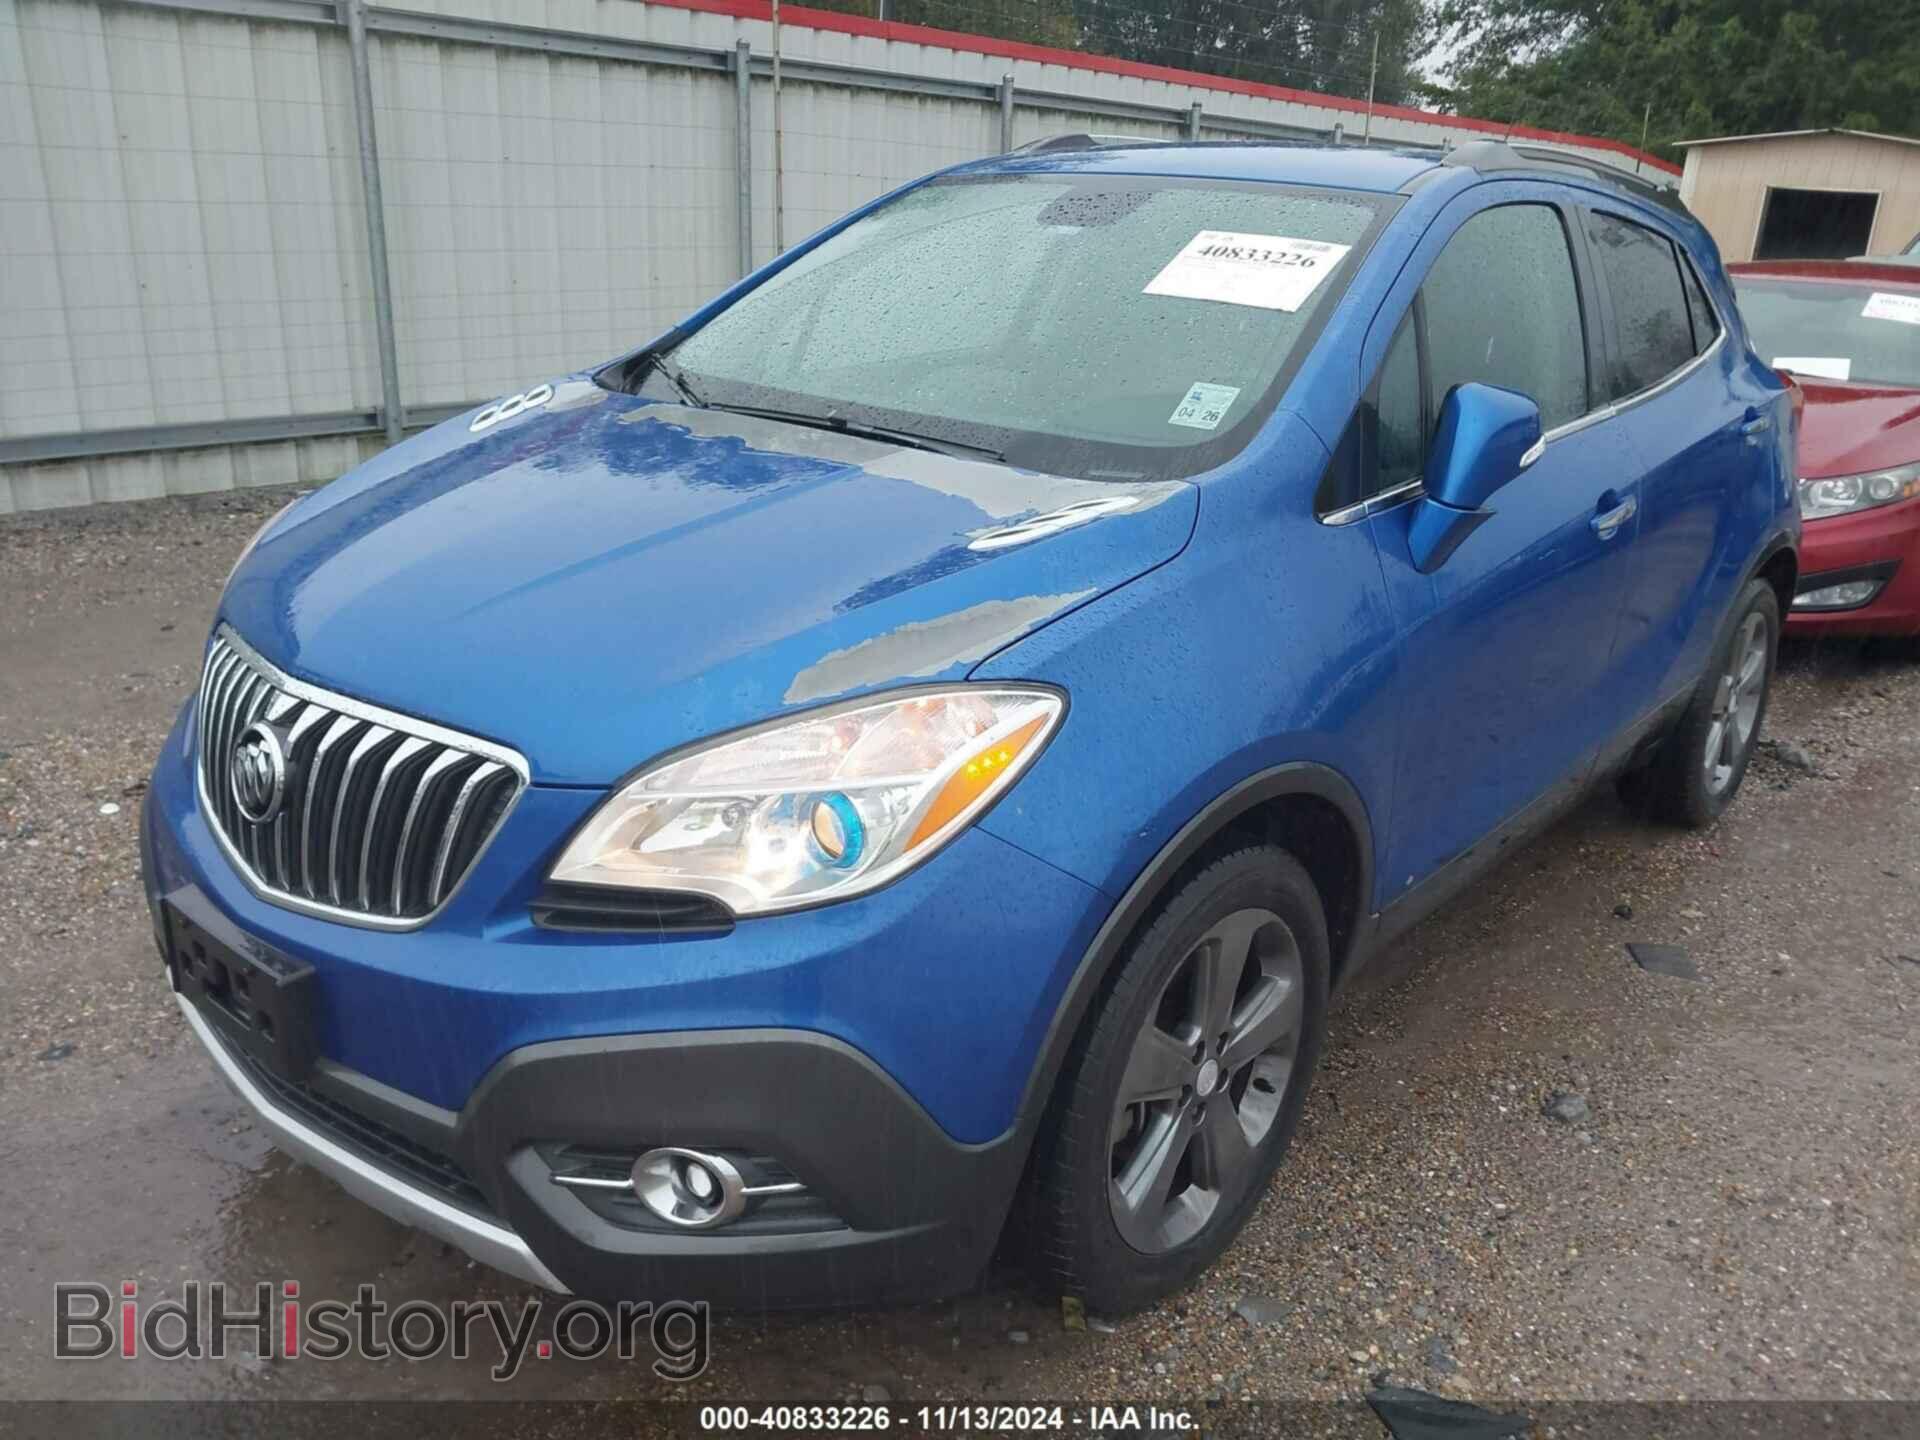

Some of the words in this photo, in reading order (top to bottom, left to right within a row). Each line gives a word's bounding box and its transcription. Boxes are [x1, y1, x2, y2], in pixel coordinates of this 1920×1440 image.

[1198, 244, 1316, 268] 40833226
[1177, 407, 1195, 419] 04
[1201, 410, 1220, 423] 26
